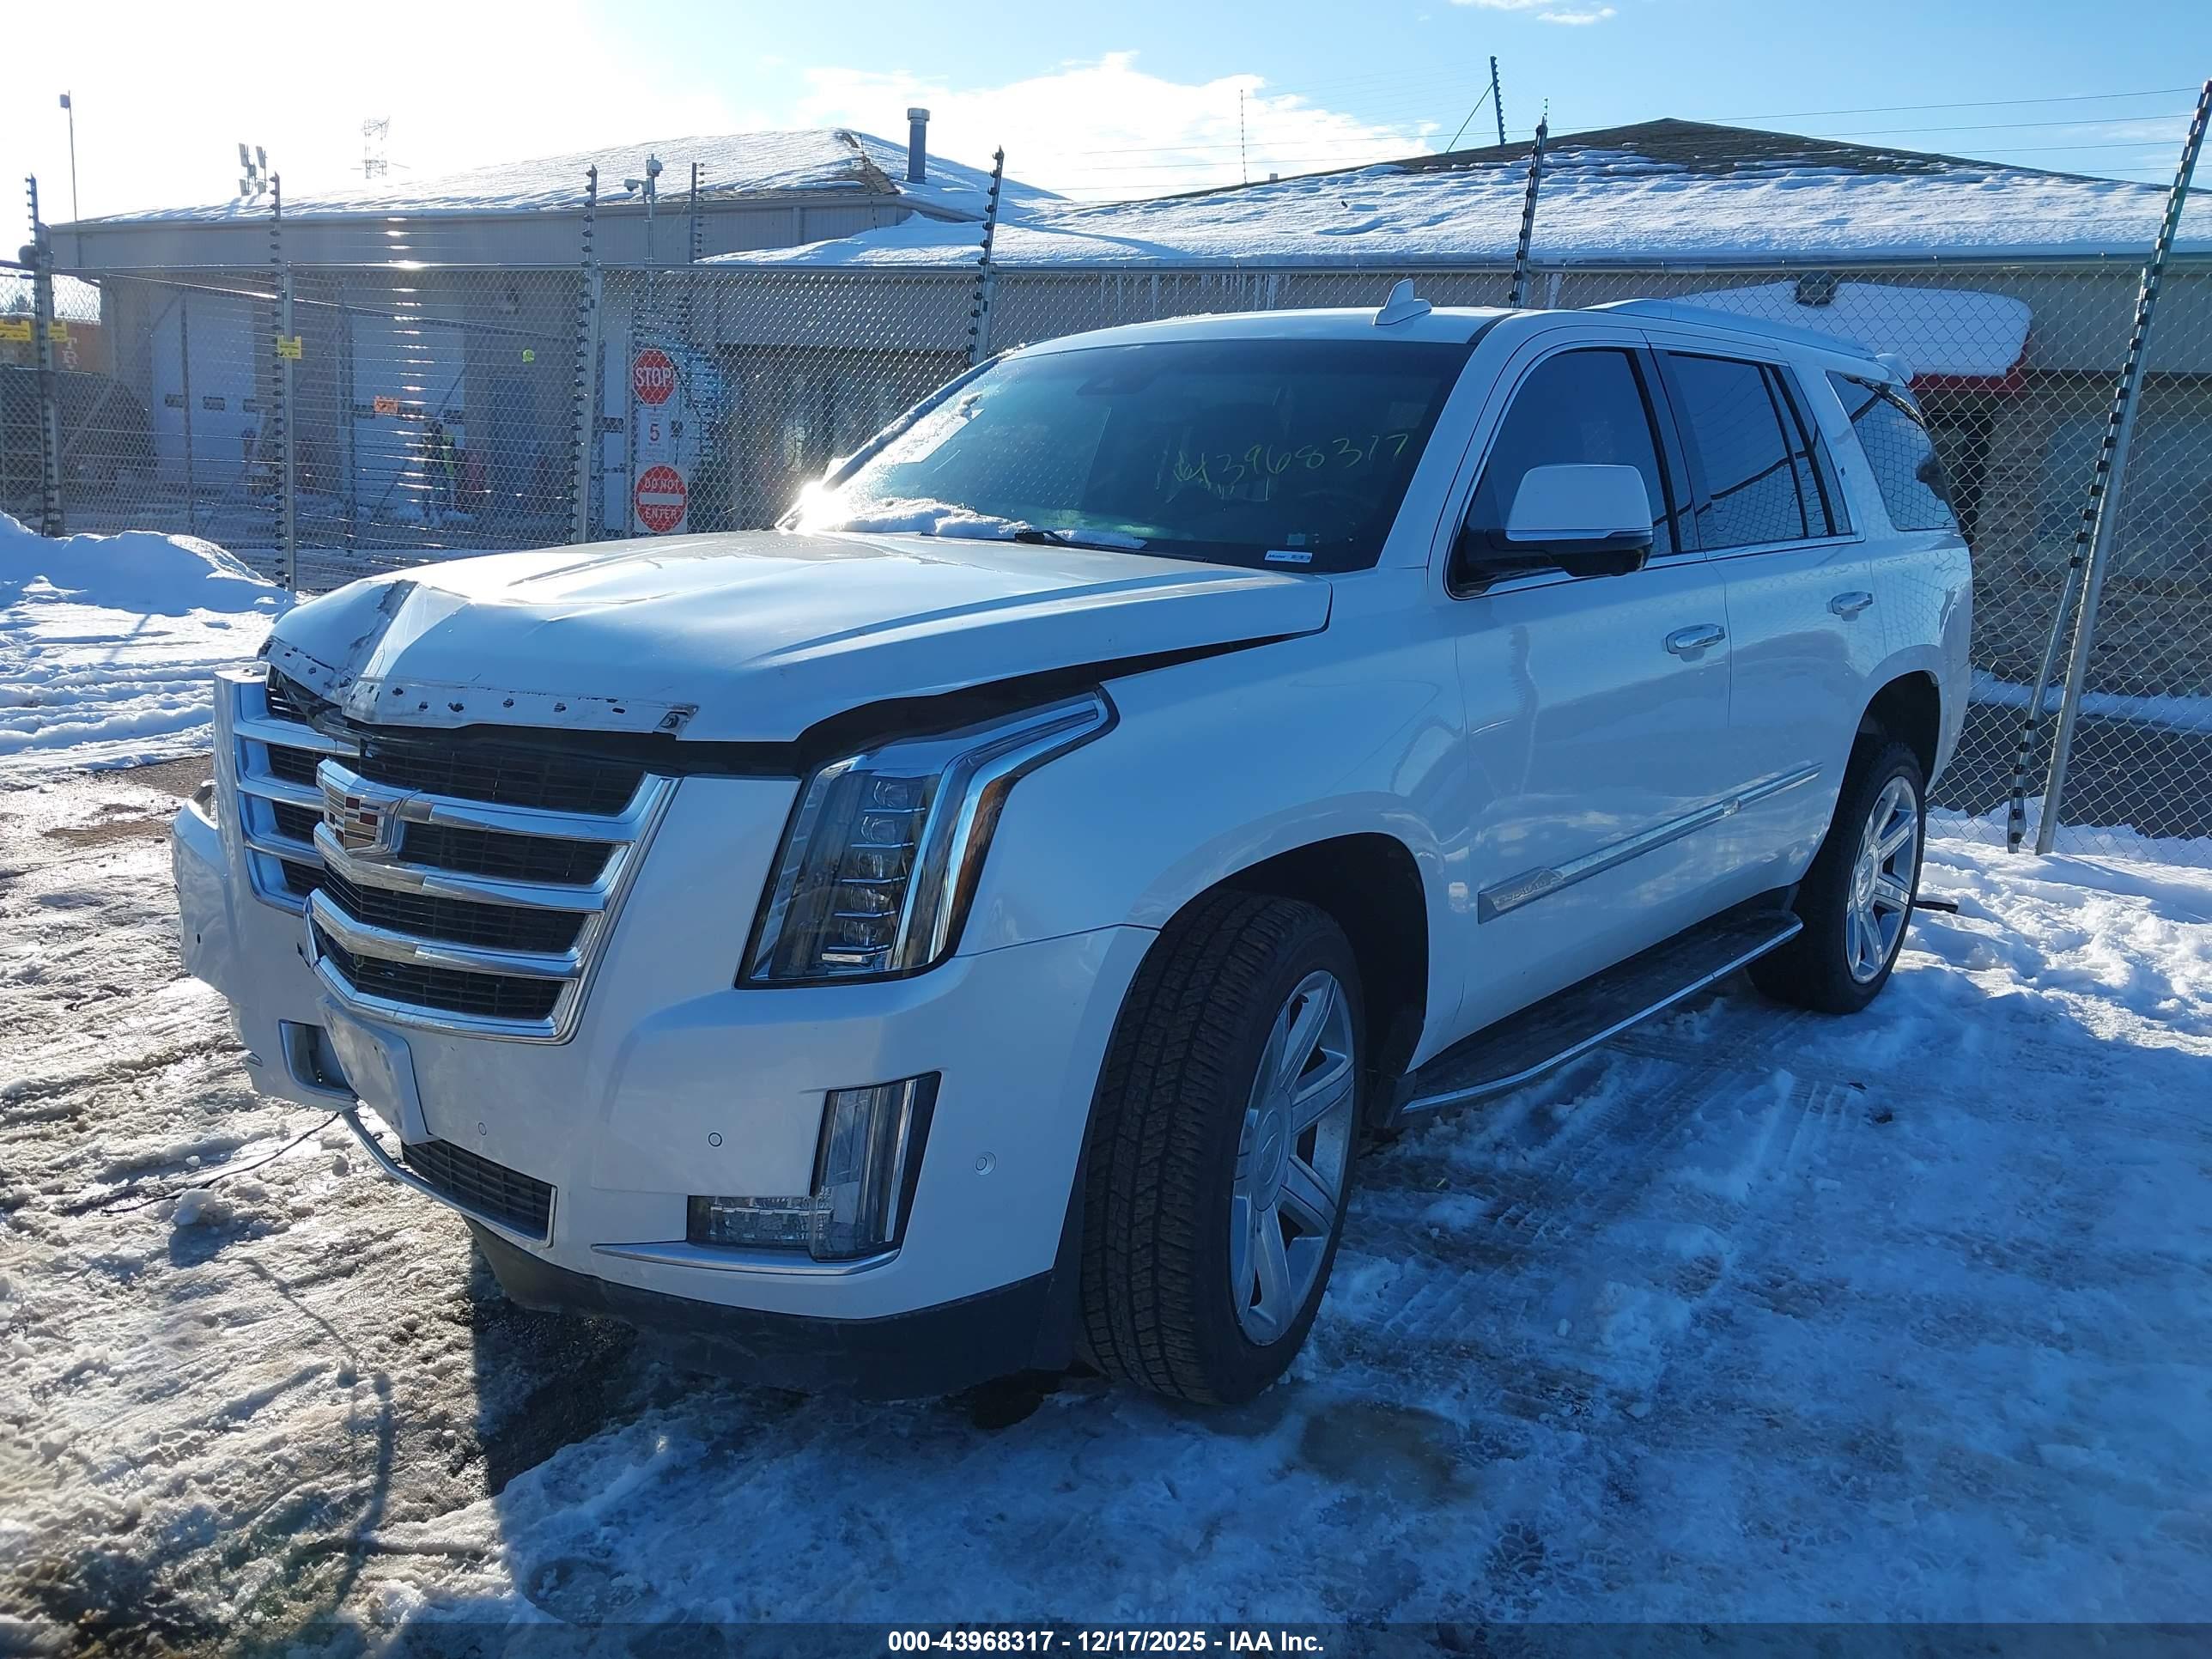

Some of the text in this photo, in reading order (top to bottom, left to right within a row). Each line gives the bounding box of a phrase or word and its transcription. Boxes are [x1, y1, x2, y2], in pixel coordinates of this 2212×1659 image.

[635, 368, 672, 386] STOP
[649, 423, 660, 441] 5
[644, 478, 680, 490] DO NOT
[645, 507, 678, 520] ENTER
